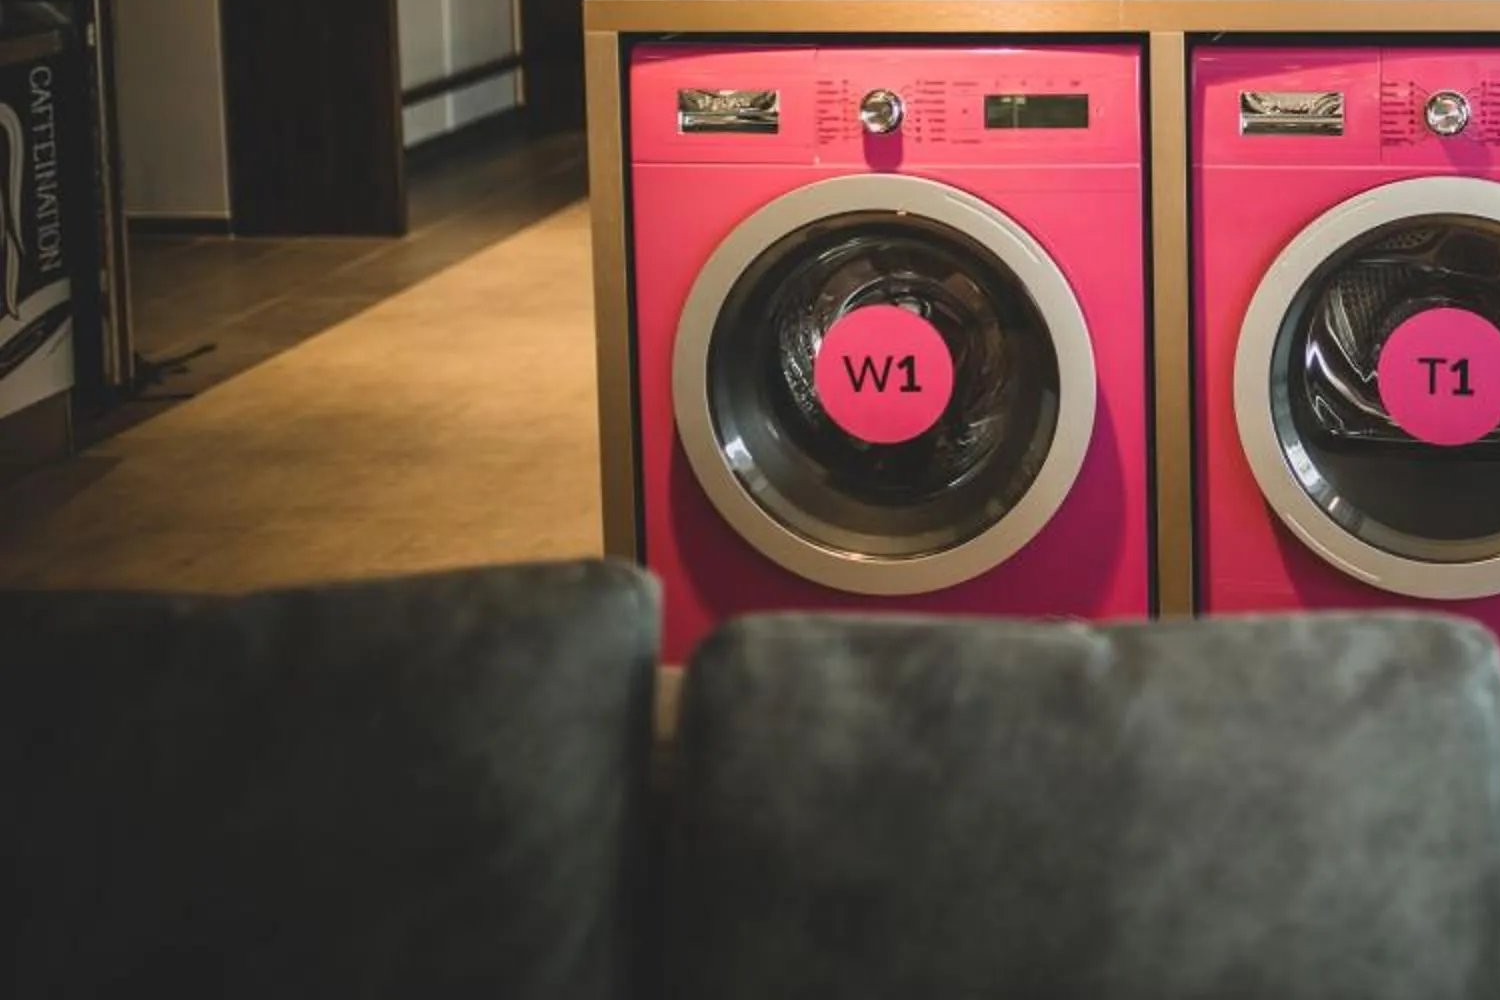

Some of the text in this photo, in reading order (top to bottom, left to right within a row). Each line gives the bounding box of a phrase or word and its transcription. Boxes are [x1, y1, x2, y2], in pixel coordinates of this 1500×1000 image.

[28, 64, 62, 273] CAFFEINATION
[843, 354, 922, 394] W1
[1417, 356, 1475, 398] T1
